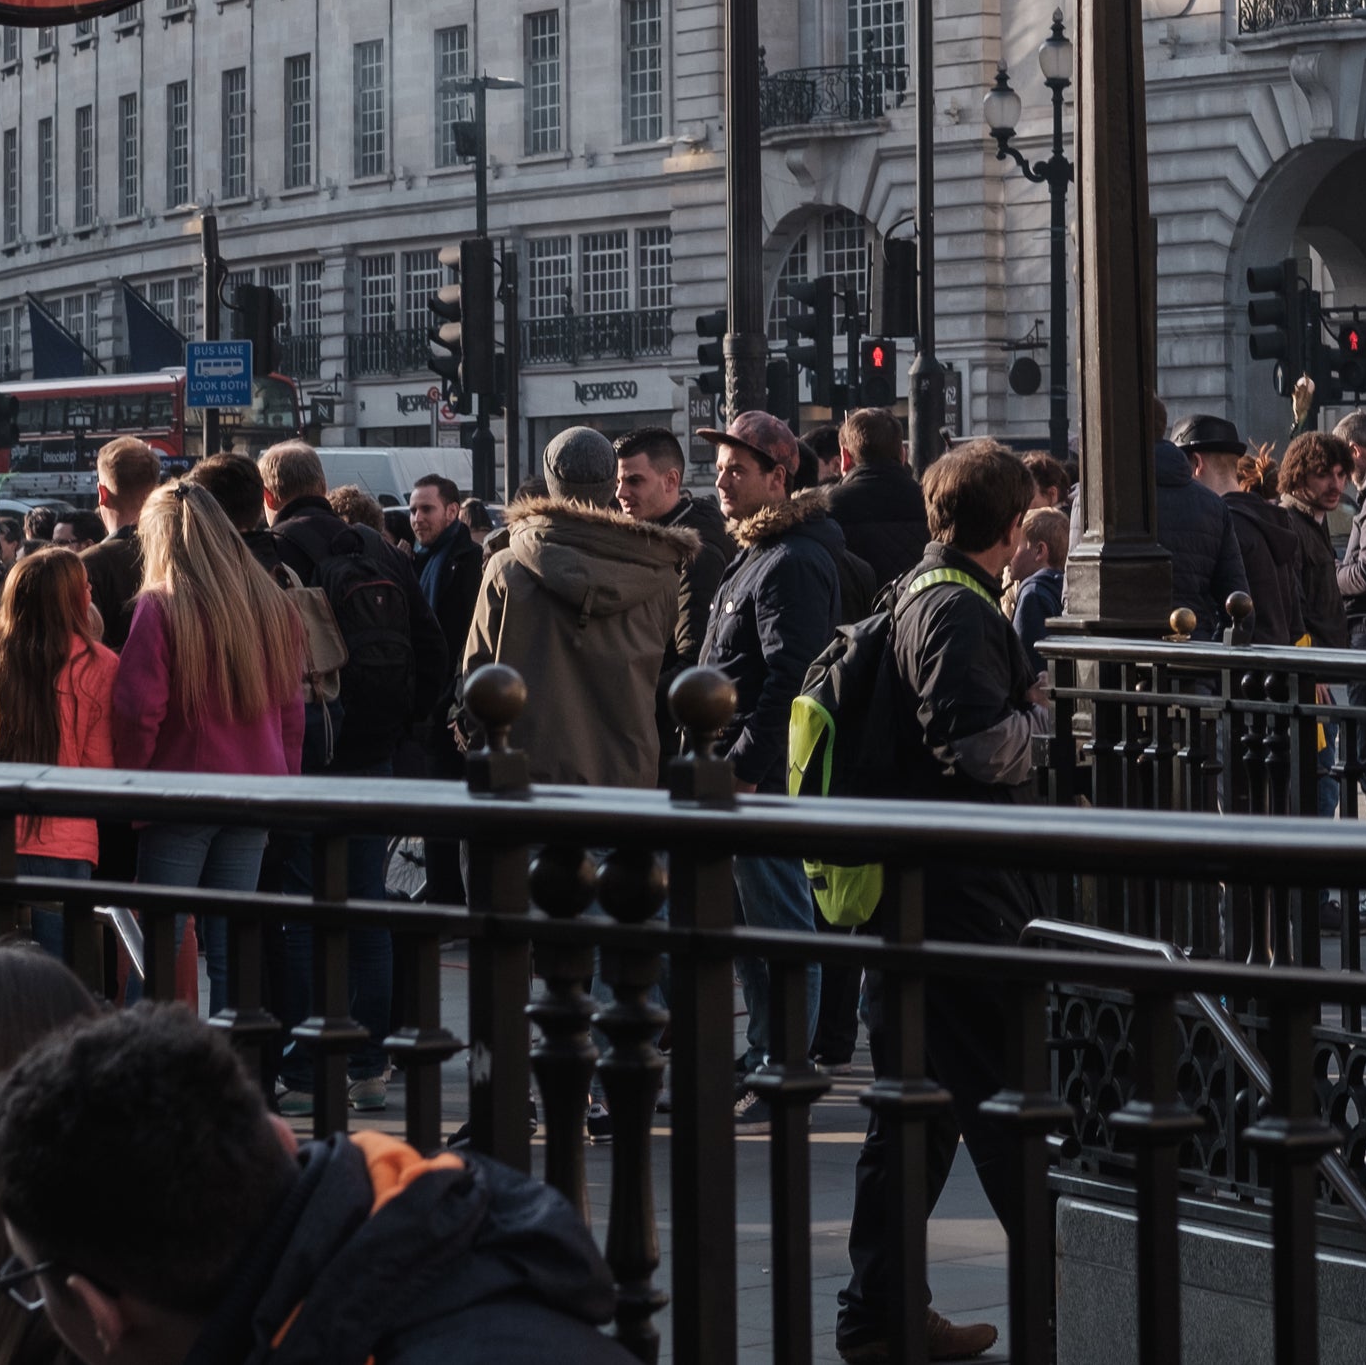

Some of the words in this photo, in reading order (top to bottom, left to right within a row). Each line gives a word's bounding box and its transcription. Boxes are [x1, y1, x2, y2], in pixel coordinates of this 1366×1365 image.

[194, 345, 215, 355] BUS
[218, 345, 244, 355] LANE
[190, 381, 217, 392] LOOK
[220, 380, 248, 391] BOTH
[573, 380, 639, 406] NESPRESSO
[205, 394, 234, 404] WAYS
